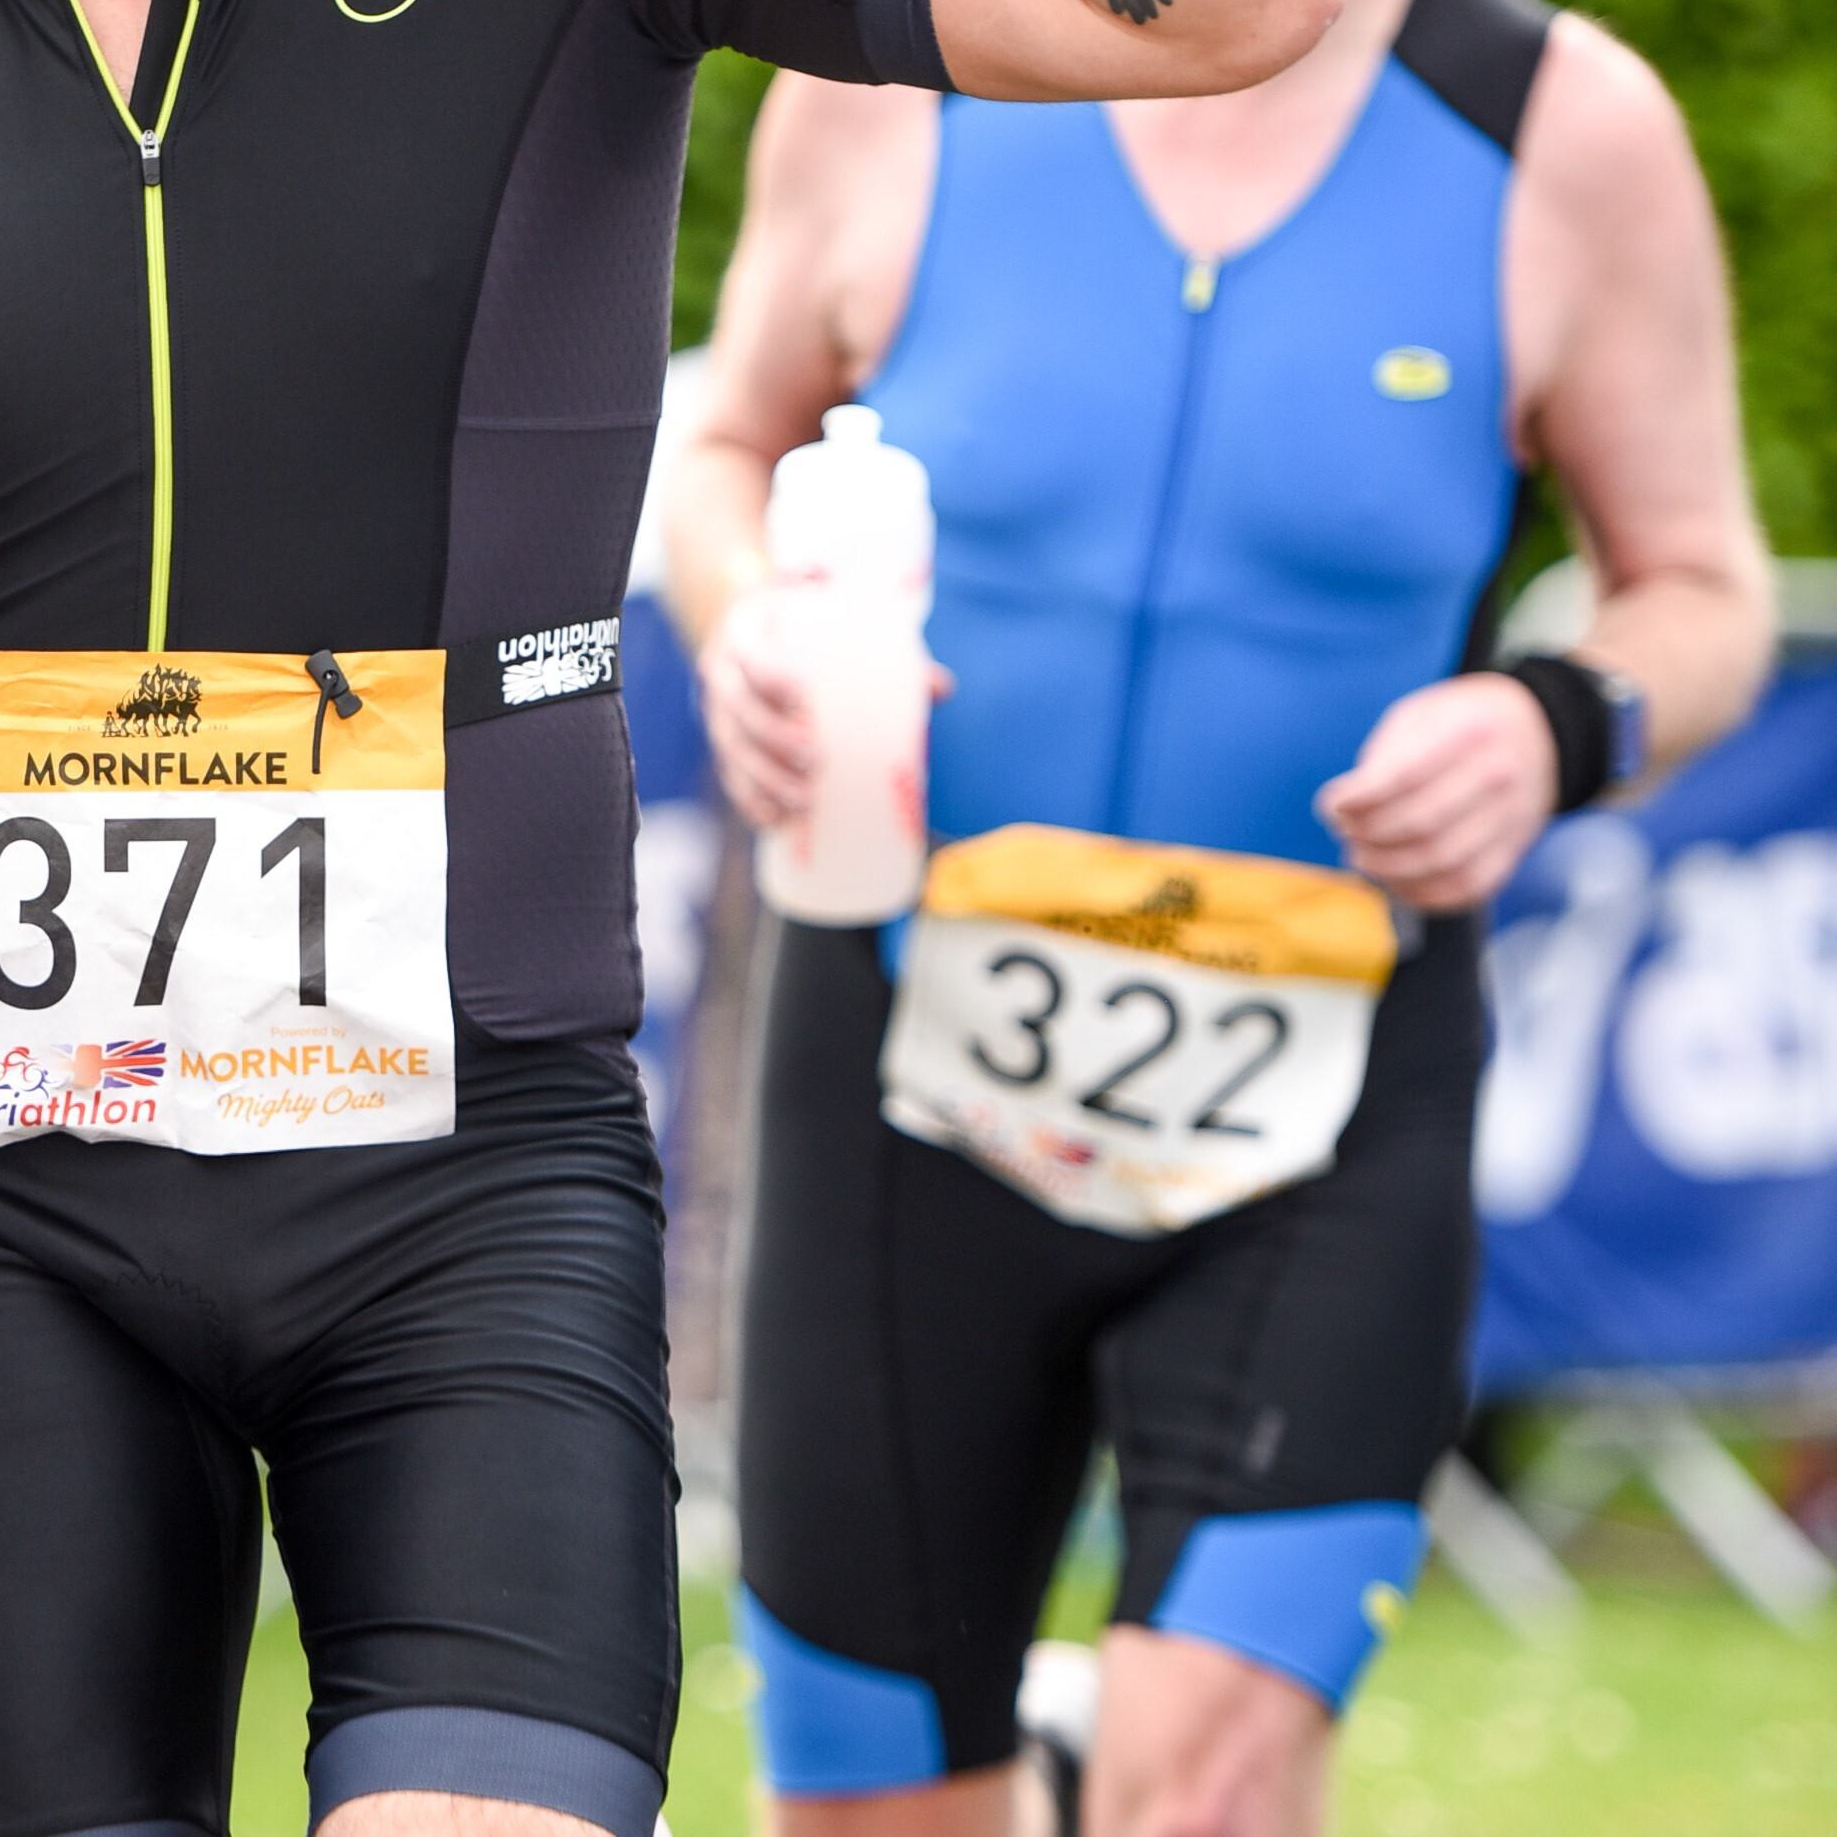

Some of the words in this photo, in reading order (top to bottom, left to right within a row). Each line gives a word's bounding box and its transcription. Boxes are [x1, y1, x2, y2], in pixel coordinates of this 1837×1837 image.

[23, 751, 287, 787] MORNFLAKE
[967, 948, 1291, 1137] 322
[180, 1045, 429, 1082] MORNFLAKE
[217, 1088, 317, 1127] Mighty
[322, 1085, 386, 1115] Oats
